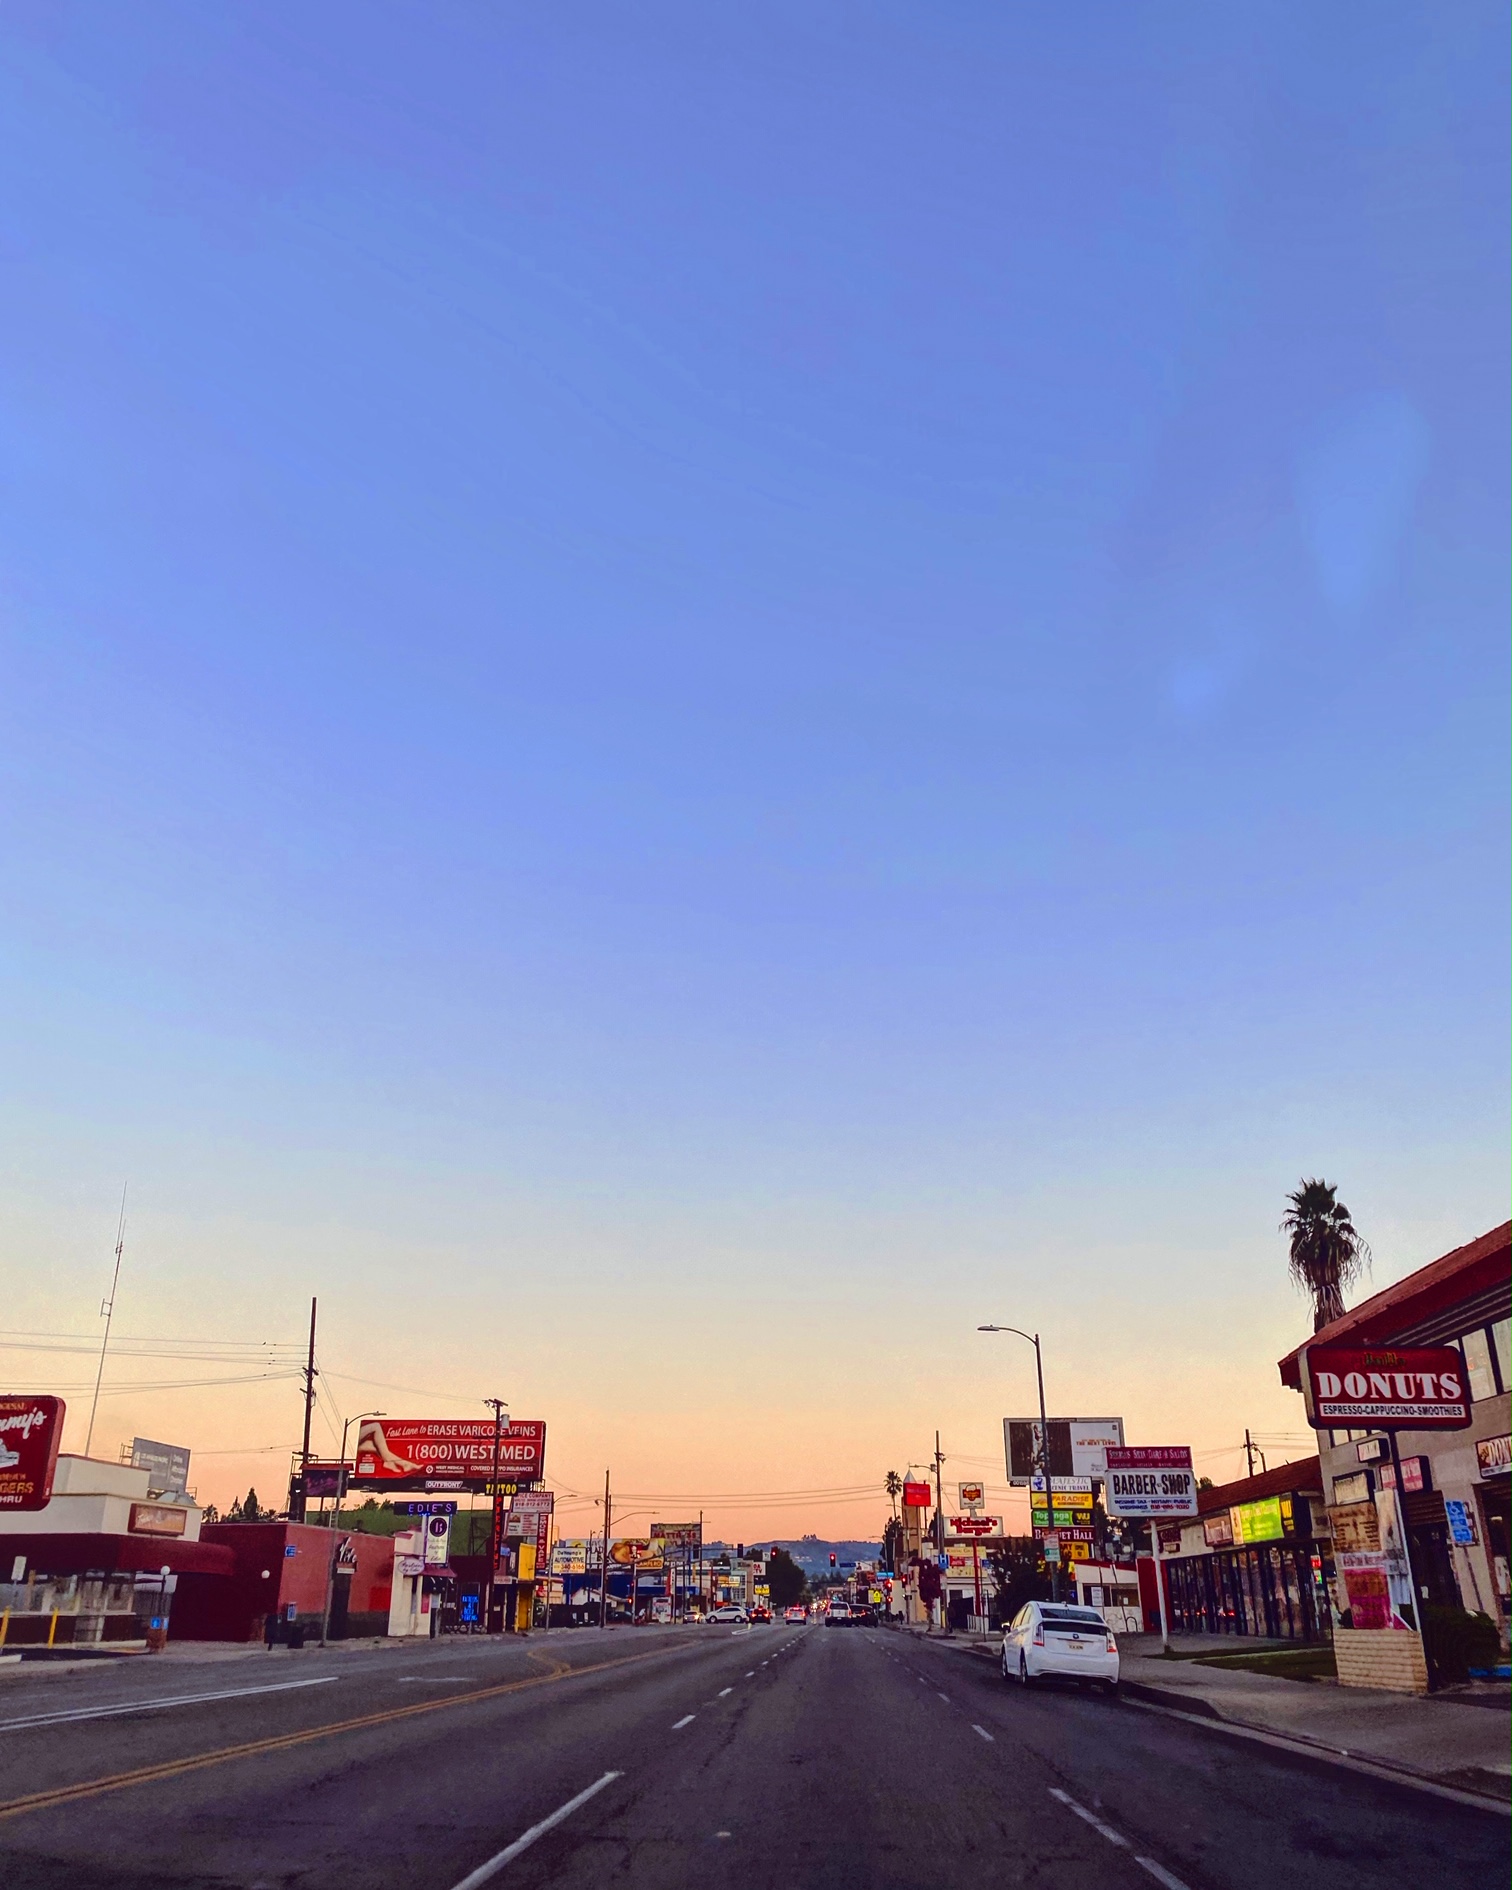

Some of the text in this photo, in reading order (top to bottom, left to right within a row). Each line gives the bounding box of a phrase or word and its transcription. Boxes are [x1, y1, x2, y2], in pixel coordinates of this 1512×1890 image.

[1315, 1372, 1461, 1399] DONUTS
[386, 1427, 401, 1438] Fast
[402, 1427, 418, 1436] Lane
[419, 1425, 427, 1434] to
[427, 1425, 457, 1436] ERASE
[459, 1425, 505, 1437] VARICOE
[1113, 1474, 1158, 1495] BARBER
[949, 1517, 998, 1527] Michael's
[956, 1526, 993, 1537] Burger
[1073, 1529, 1094, 1540] HALL
